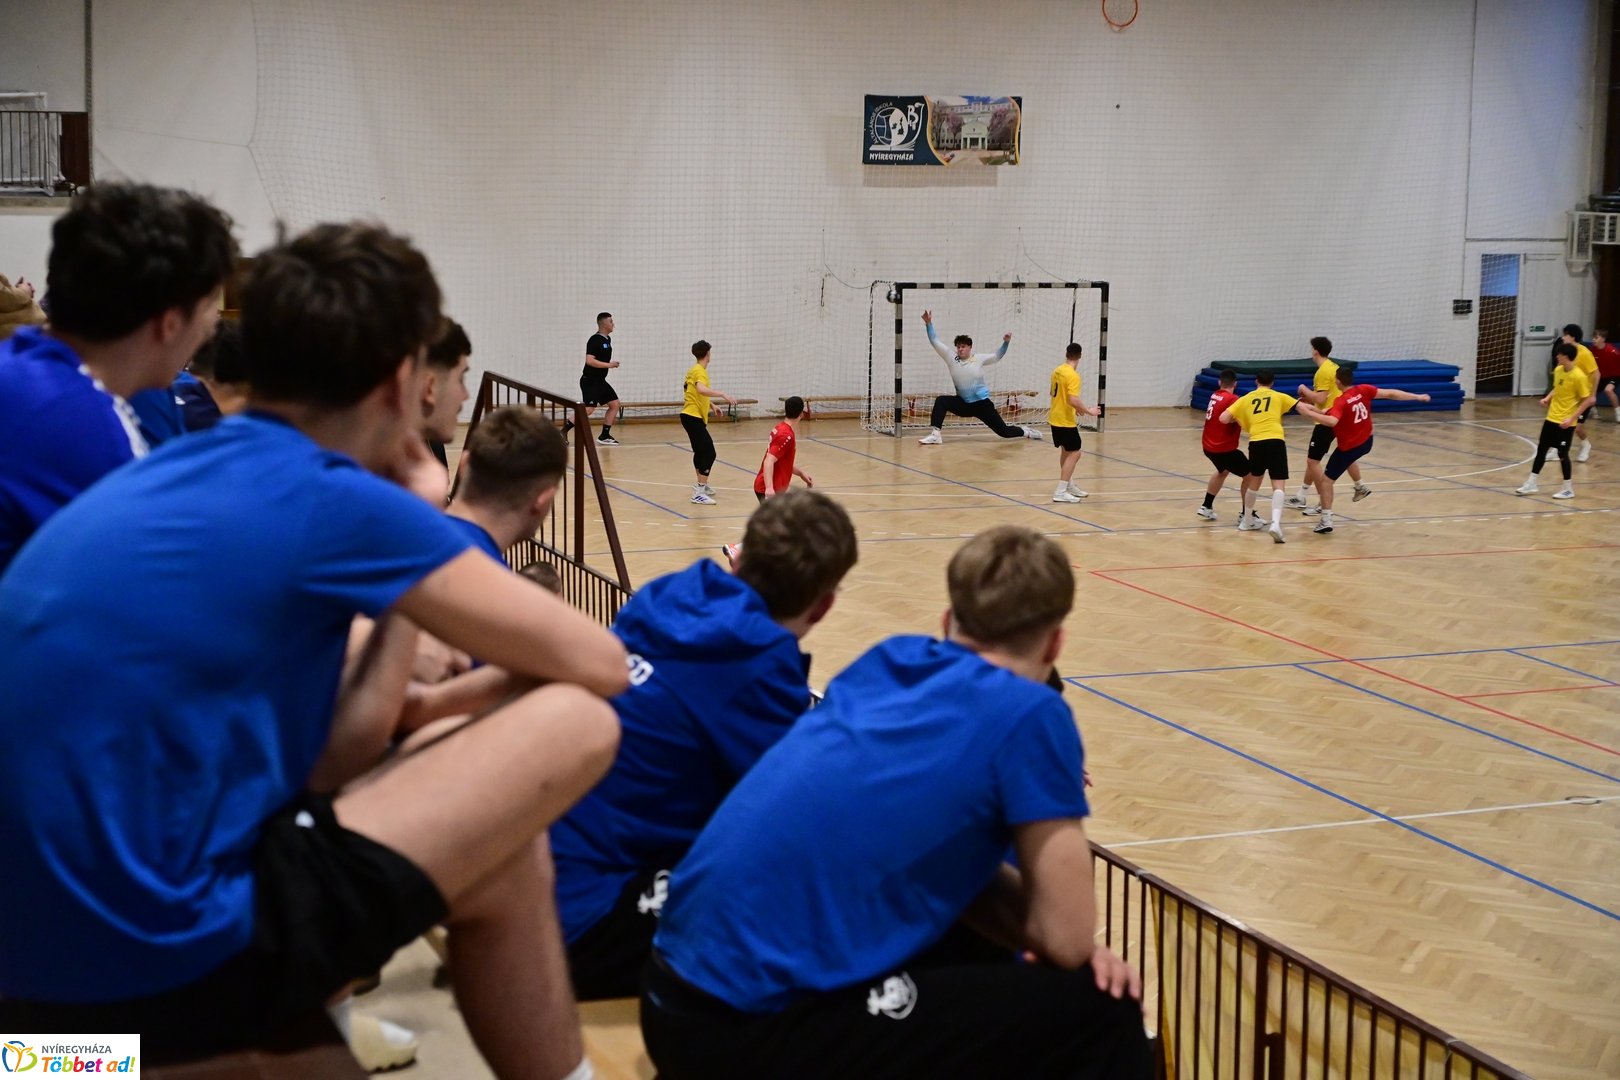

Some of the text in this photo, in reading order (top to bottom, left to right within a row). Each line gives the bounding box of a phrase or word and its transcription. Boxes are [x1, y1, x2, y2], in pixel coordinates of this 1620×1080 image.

[869, 152, 914, 160] NYÍREGYHÁZA
[1251, 396, 1272, 415] 27
[1351, 401, 1369, 424] 28
